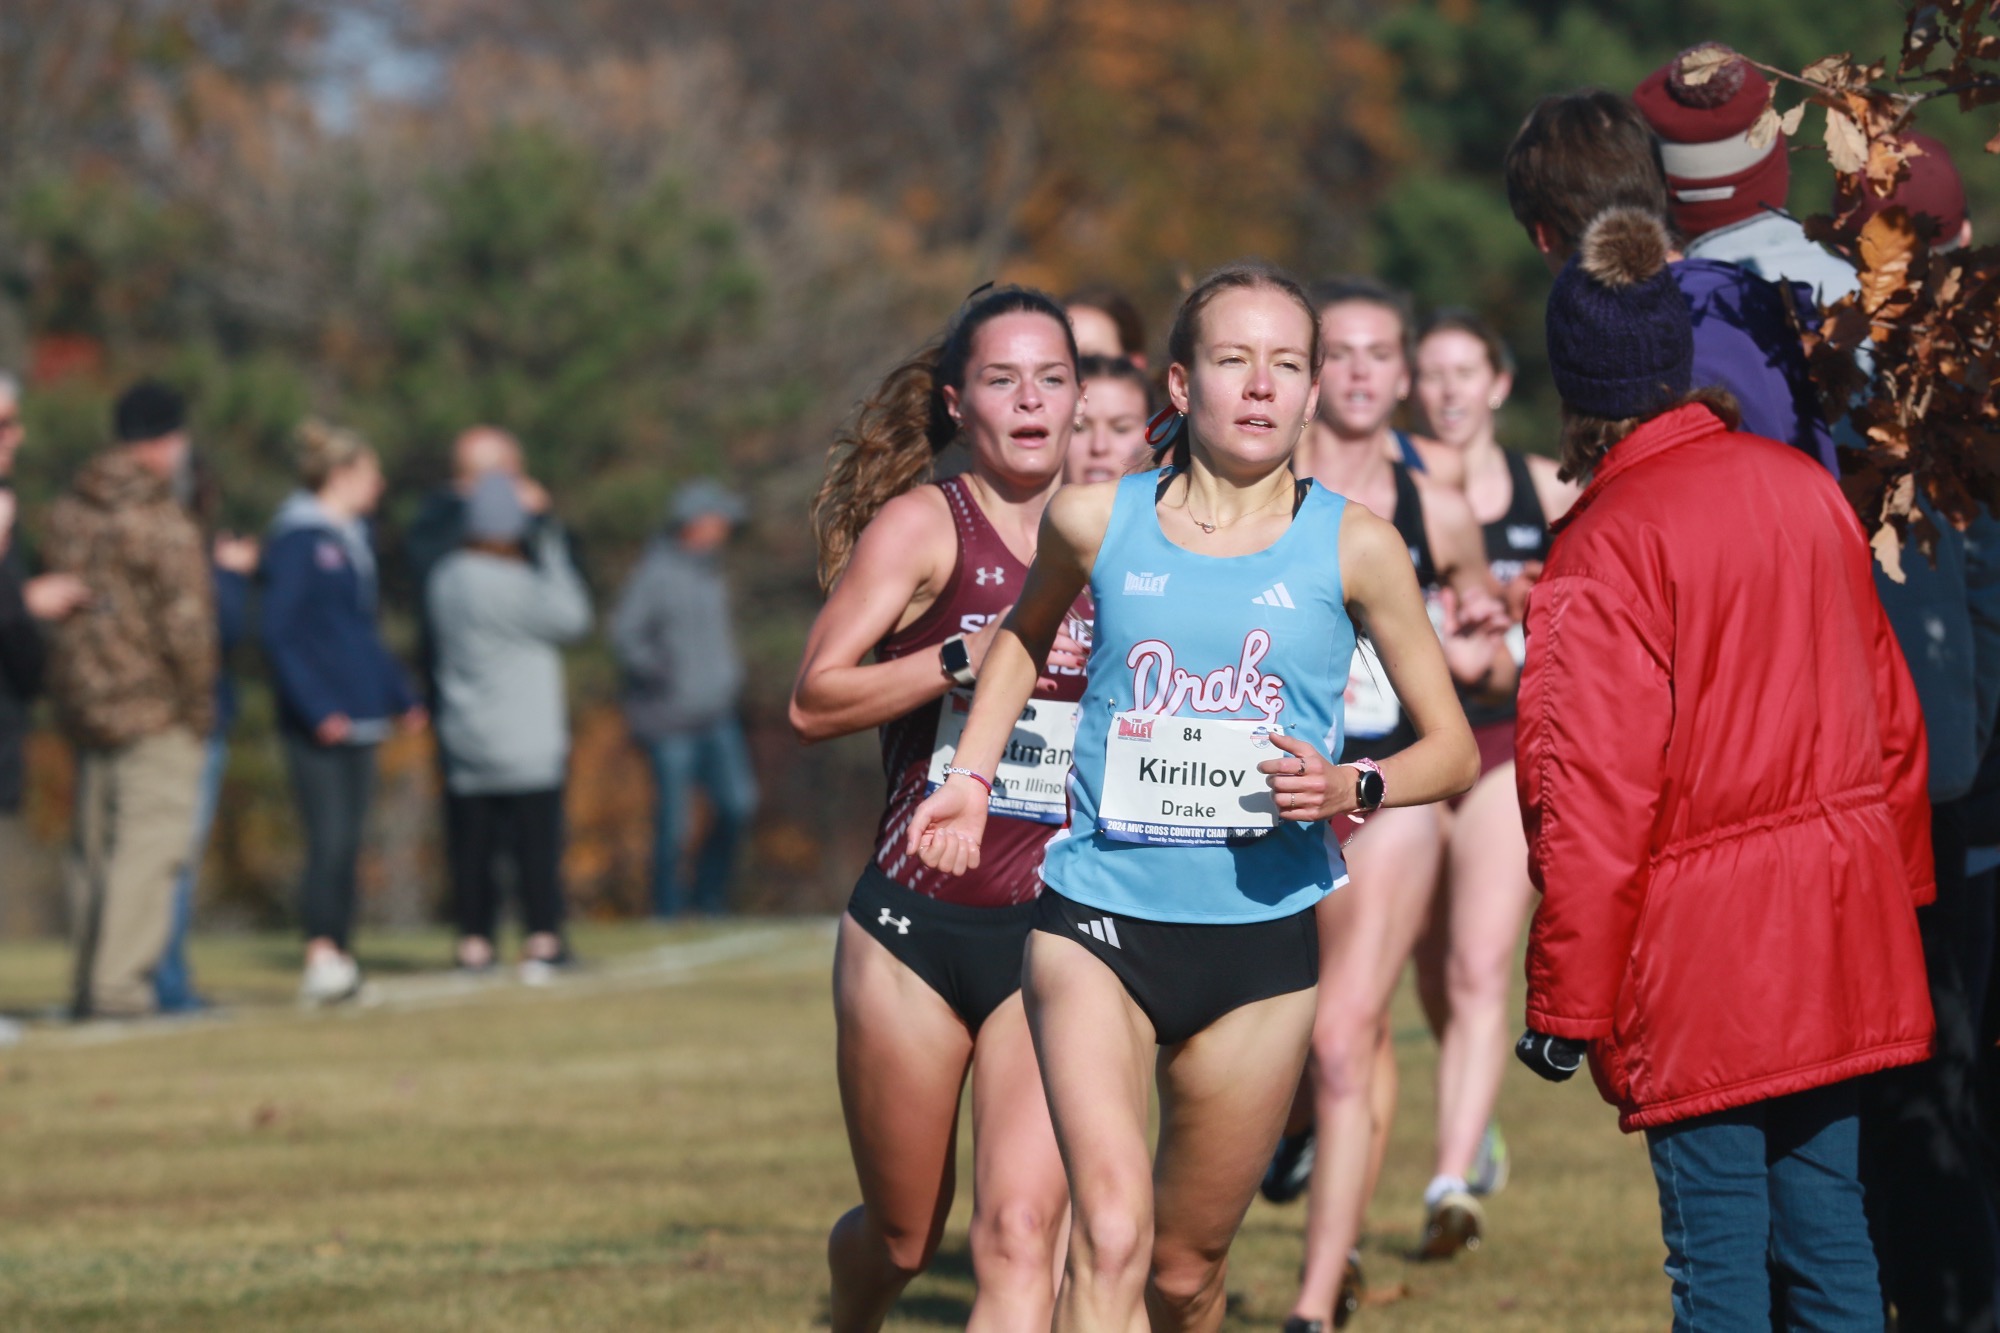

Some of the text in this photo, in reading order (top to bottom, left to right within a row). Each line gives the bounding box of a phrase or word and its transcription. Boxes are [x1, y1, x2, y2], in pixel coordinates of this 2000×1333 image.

[1123, 571, 1170, 592] VALLEY
[1126, 628, 1285, 719] Drake
[1183, 727, 1202, 742] 84
[1139, 757, 1246, 788] Kirillov
[1161, 800, 1216, 818] Drake
[1107, 820, 1126, 831] 2024
[1126, 823, 1144, 834] MVC
[1144, 825, 1169, 836] CROSS
[1170, 826, 1206, 837] COUNTRY
